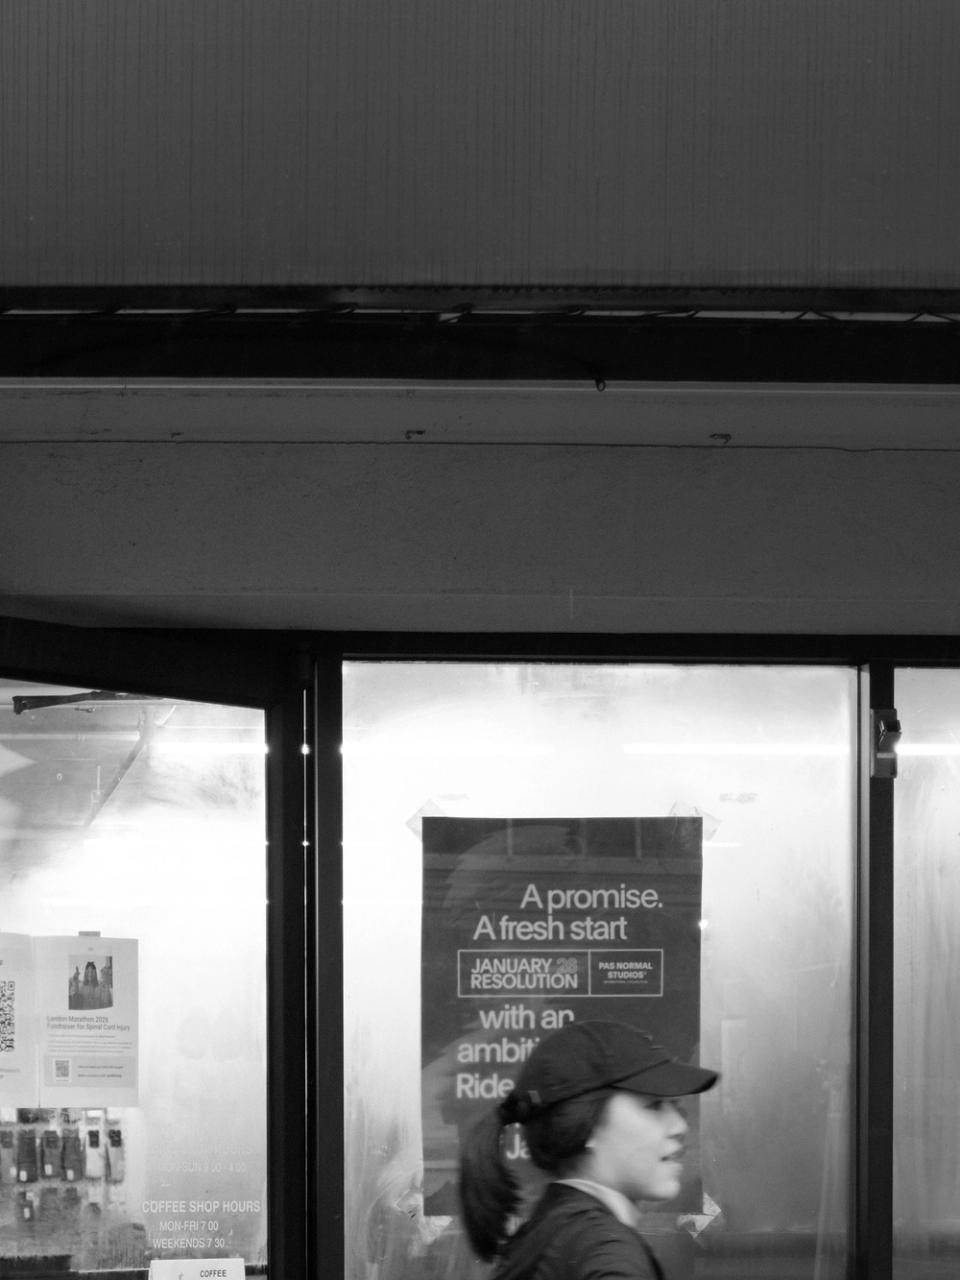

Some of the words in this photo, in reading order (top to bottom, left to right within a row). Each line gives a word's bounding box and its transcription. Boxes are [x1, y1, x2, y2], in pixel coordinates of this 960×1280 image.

[520, 883, 543, 909] A
[548, 883, 663, 914] promise.
[473, 915, 497, 940] A
[499, 915, 565, 940] fresh
[570, 917, 628, 940] start
[470, 958, 552, 974] JANUARY
[598, 962, 615, 970] PAS
[616, 962, 653, 970] NORMAL
[470, 974, 579, 989] RESOLUTION
[479, 1004, 535, 1030] with
[541, 1009, 575, 1030] an
[456, 1037, 540, 1063] ambit
[456, 1073, 515, 1099] Ride
[505, 1134, 532, 1160] Ja
[142, 1200, 187, 1213] COFFEE
[189, 1200, 220, 1213] SHOP
[223, 1200, 261, 1213] HOURS
[159, 1220, 199, 1231] MON-FRI
[152, 1238, 205, 1249] WEEKENDS
[199, 1269, 227, 1278] COFFEE
